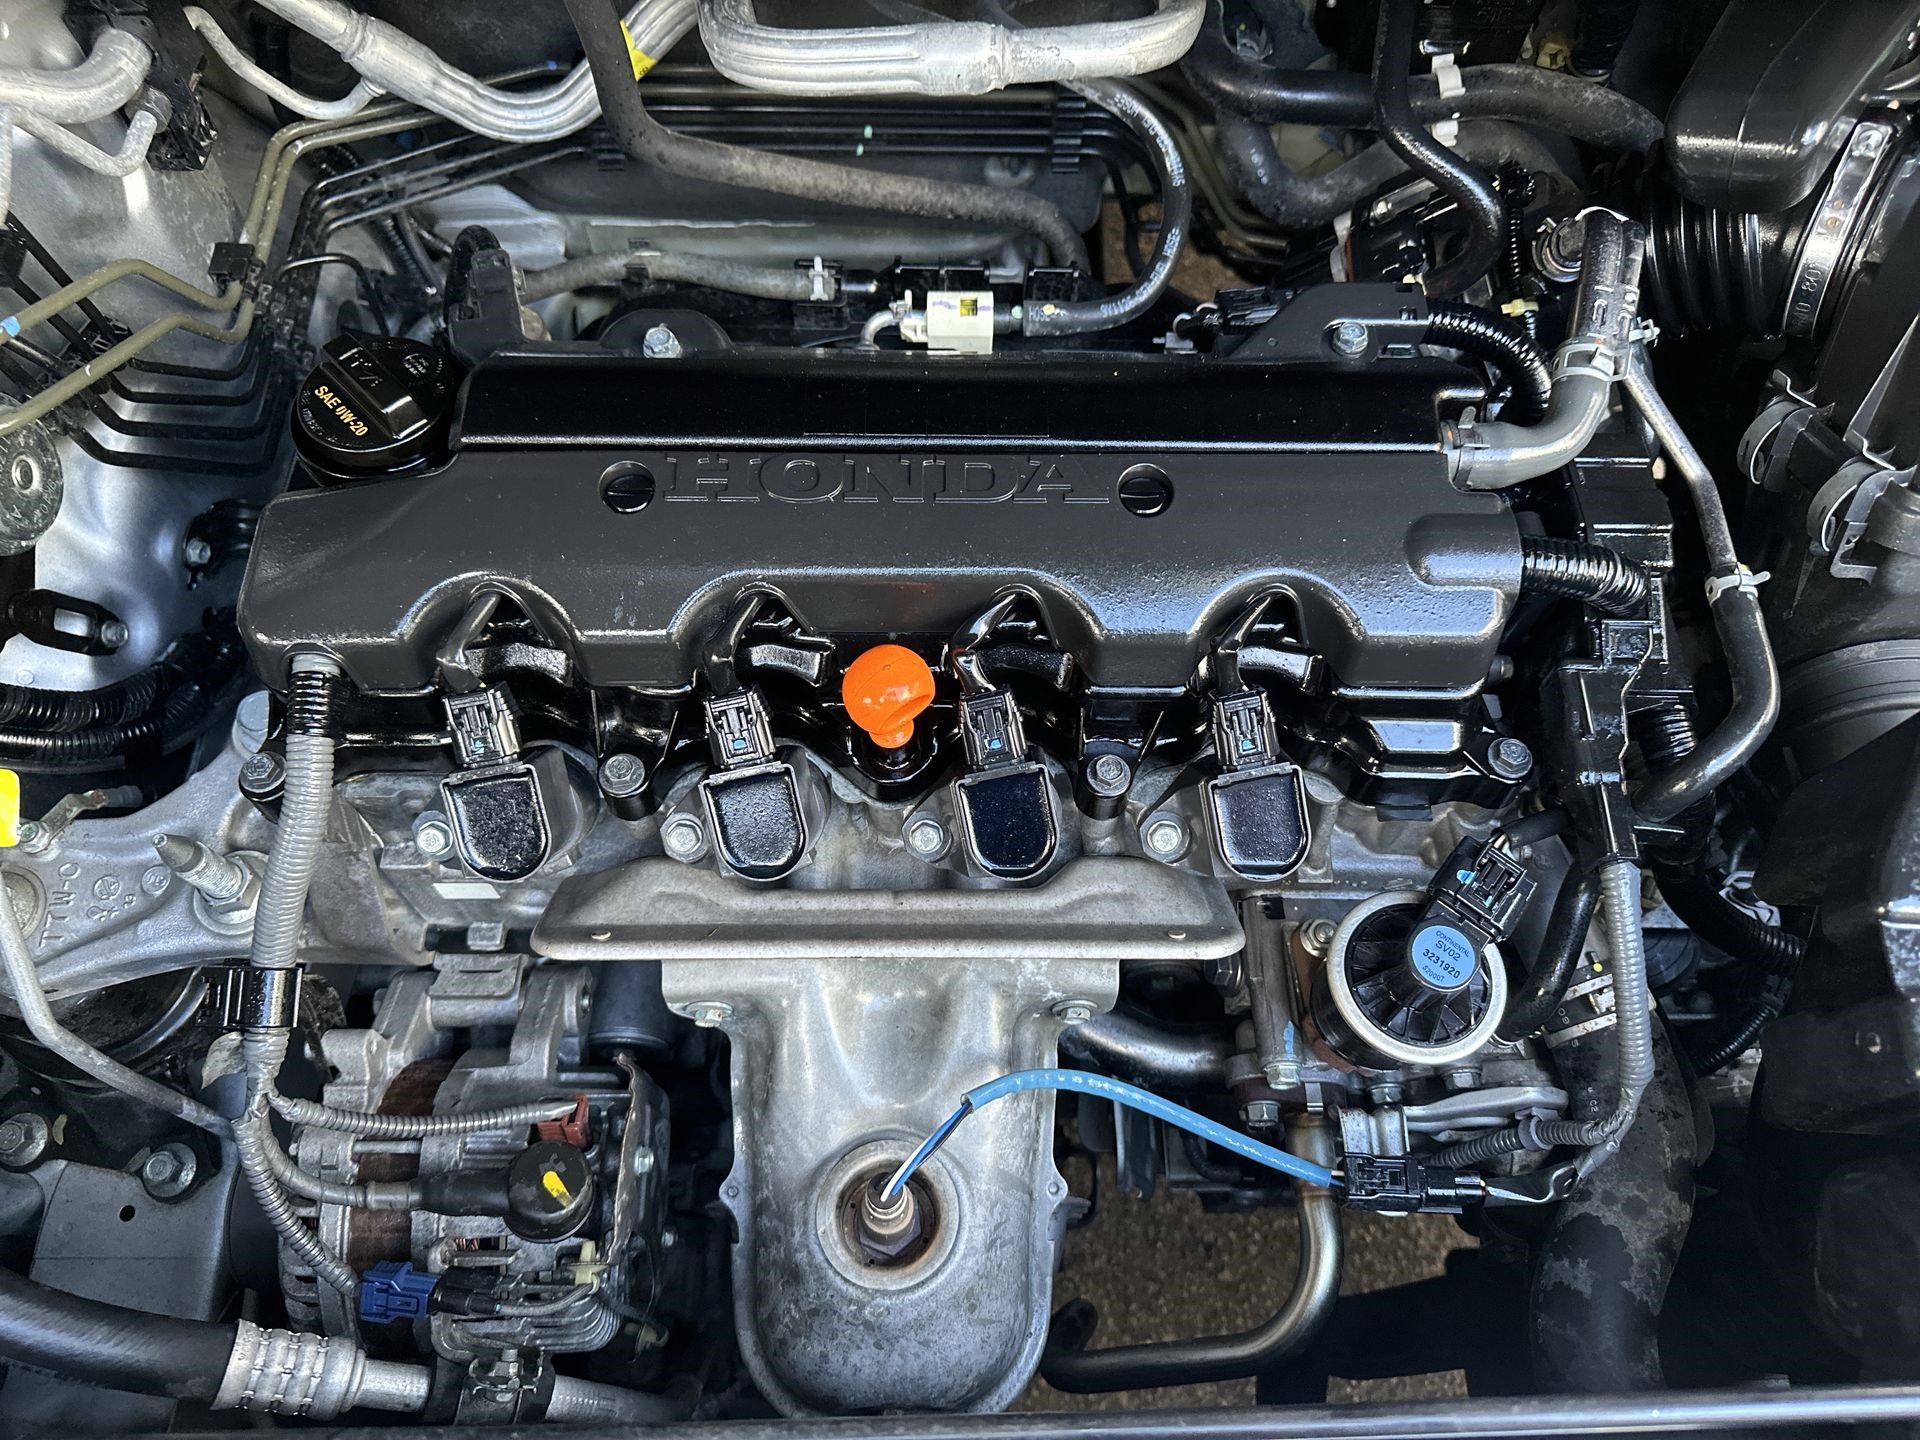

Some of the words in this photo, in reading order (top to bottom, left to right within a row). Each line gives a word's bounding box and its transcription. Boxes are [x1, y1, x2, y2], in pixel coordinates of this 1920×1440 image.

[314, 385, 342, 410] SAE
[335, 405, 369, 437] 0W-20
[664, 454, 1110, 503] HONDA
[1435, 930, 1470, 958] CONTINENTAL
[1435, 940, 1461, 962] SV02
[1422, 948, 1461, 979] 3231920
